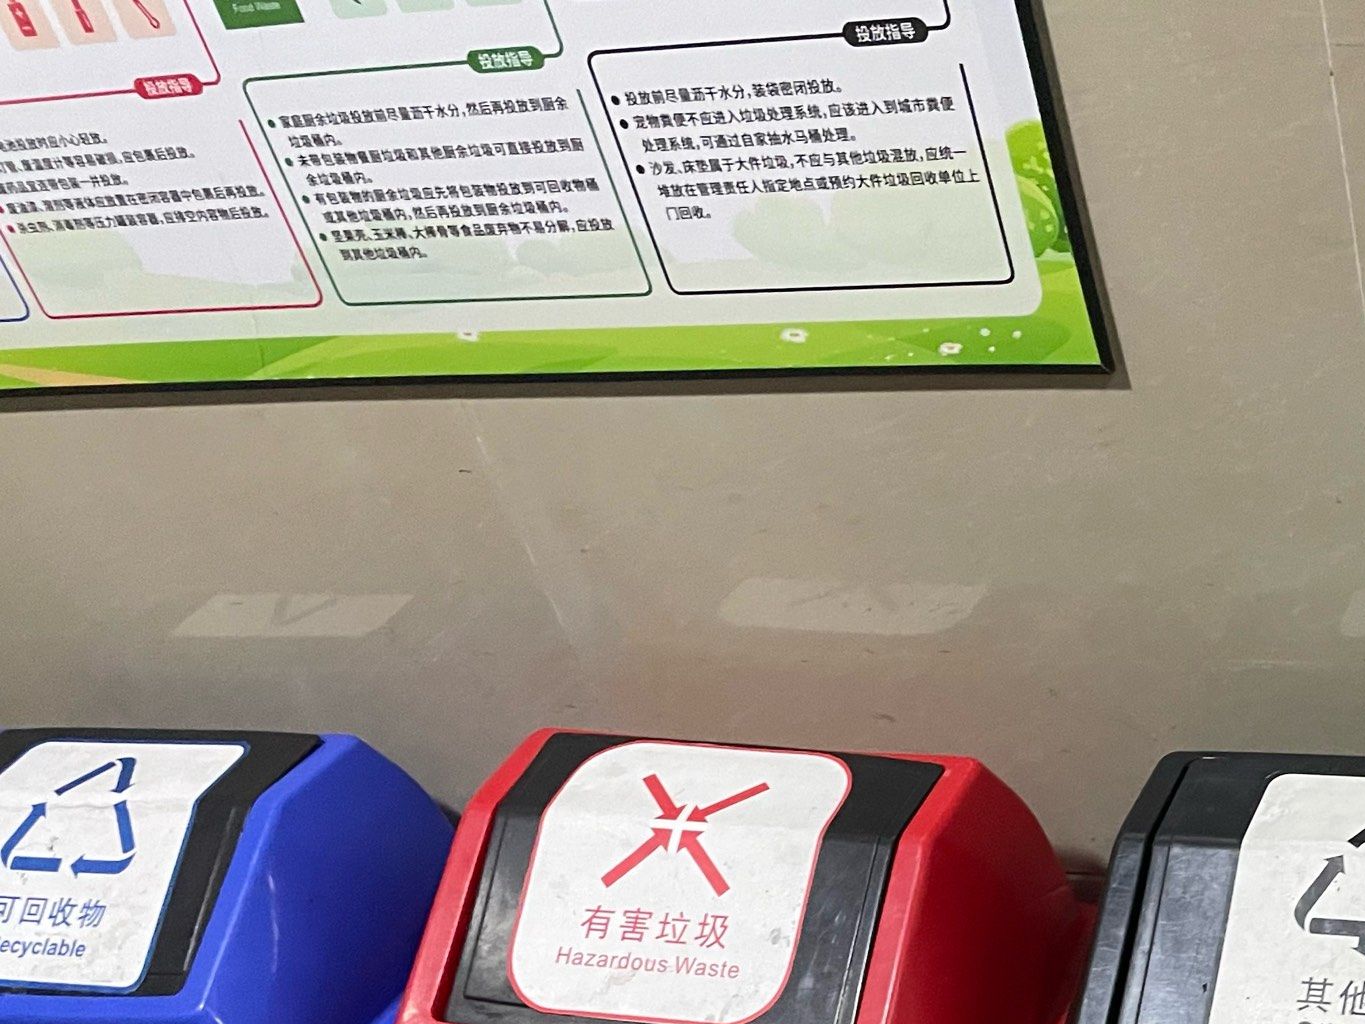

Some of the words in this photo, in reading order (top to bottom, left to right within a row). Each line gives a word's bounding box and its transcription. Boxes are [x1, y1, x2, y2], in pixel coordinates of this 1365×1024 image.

[855, 22, 916, 43] 投放指导
[478, 50, 533, 70] 投放指导
[142, 77, 193, 97] 投放指导
[666, 205, 712, 221] 门回收。
[0, 896, 107, 928] 可回收物
[580, 905, 730, 949] 有害垃圾
[0, 938, 86, 958] ecyclable
[555, 946, 669, 974] Hazardous
[674, 955, 741, 979] Waste
